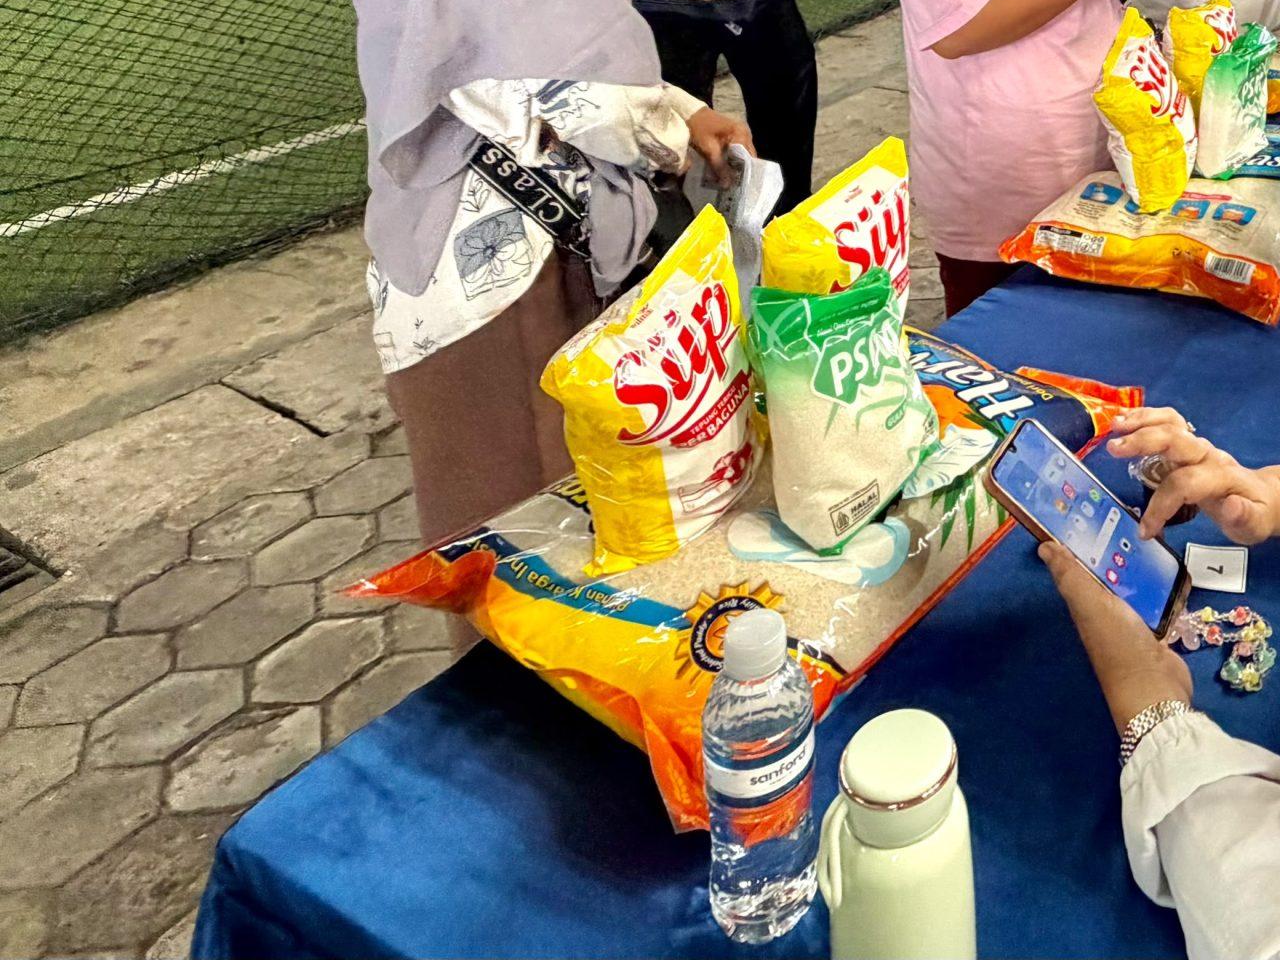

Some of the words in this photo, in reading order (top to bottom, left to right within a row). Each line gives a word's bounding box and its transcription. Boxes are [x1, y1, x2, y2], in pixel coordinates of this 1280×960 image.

[1129, 44, 1168, 115] Sii
[613, 282, 731, 442] Siip
[690, 407, 718, 435] TEPUNG
[850, 490, 879, 516] HALAL
[750, 745, 807, 786] sanford
